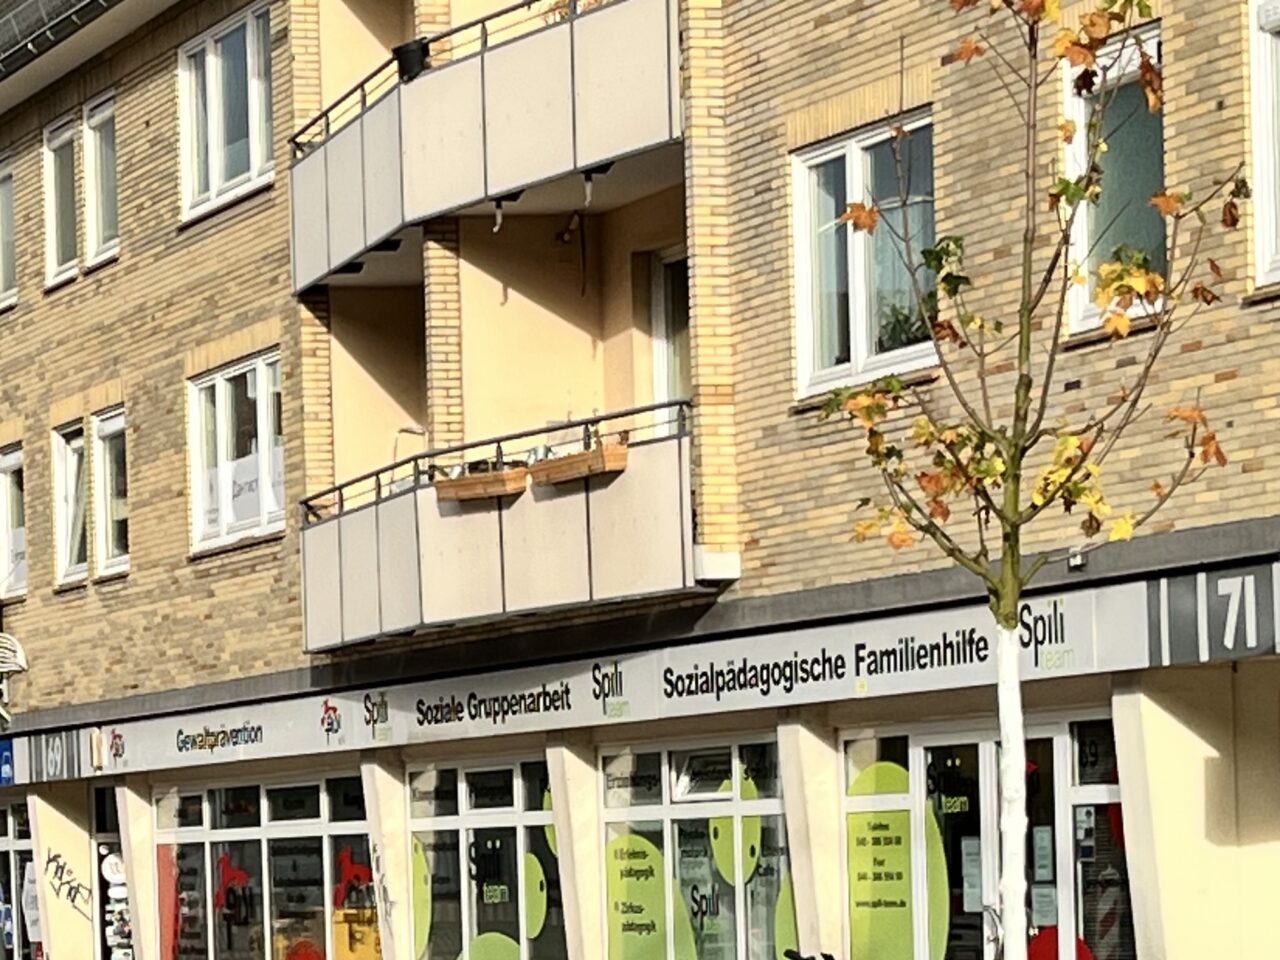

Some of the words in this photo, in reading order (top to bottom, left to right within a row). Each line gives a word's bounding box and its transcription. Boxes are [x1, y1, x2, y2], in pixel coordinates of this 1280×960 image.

[1019, 598, 1065, 667] Spili
[1217, 575, 1258, 650] 71
[592, 661, 623, 715] Spili
[663, 647, 847, 701] Sozialpädagogische
[855, 628, 989, 678] Familienhilfe
[416, 695, 464, 726] Soziale
[467, 681, 572, 724] Gruppenarbeit
[176, 721, 263, 754] Gewaltprävention
